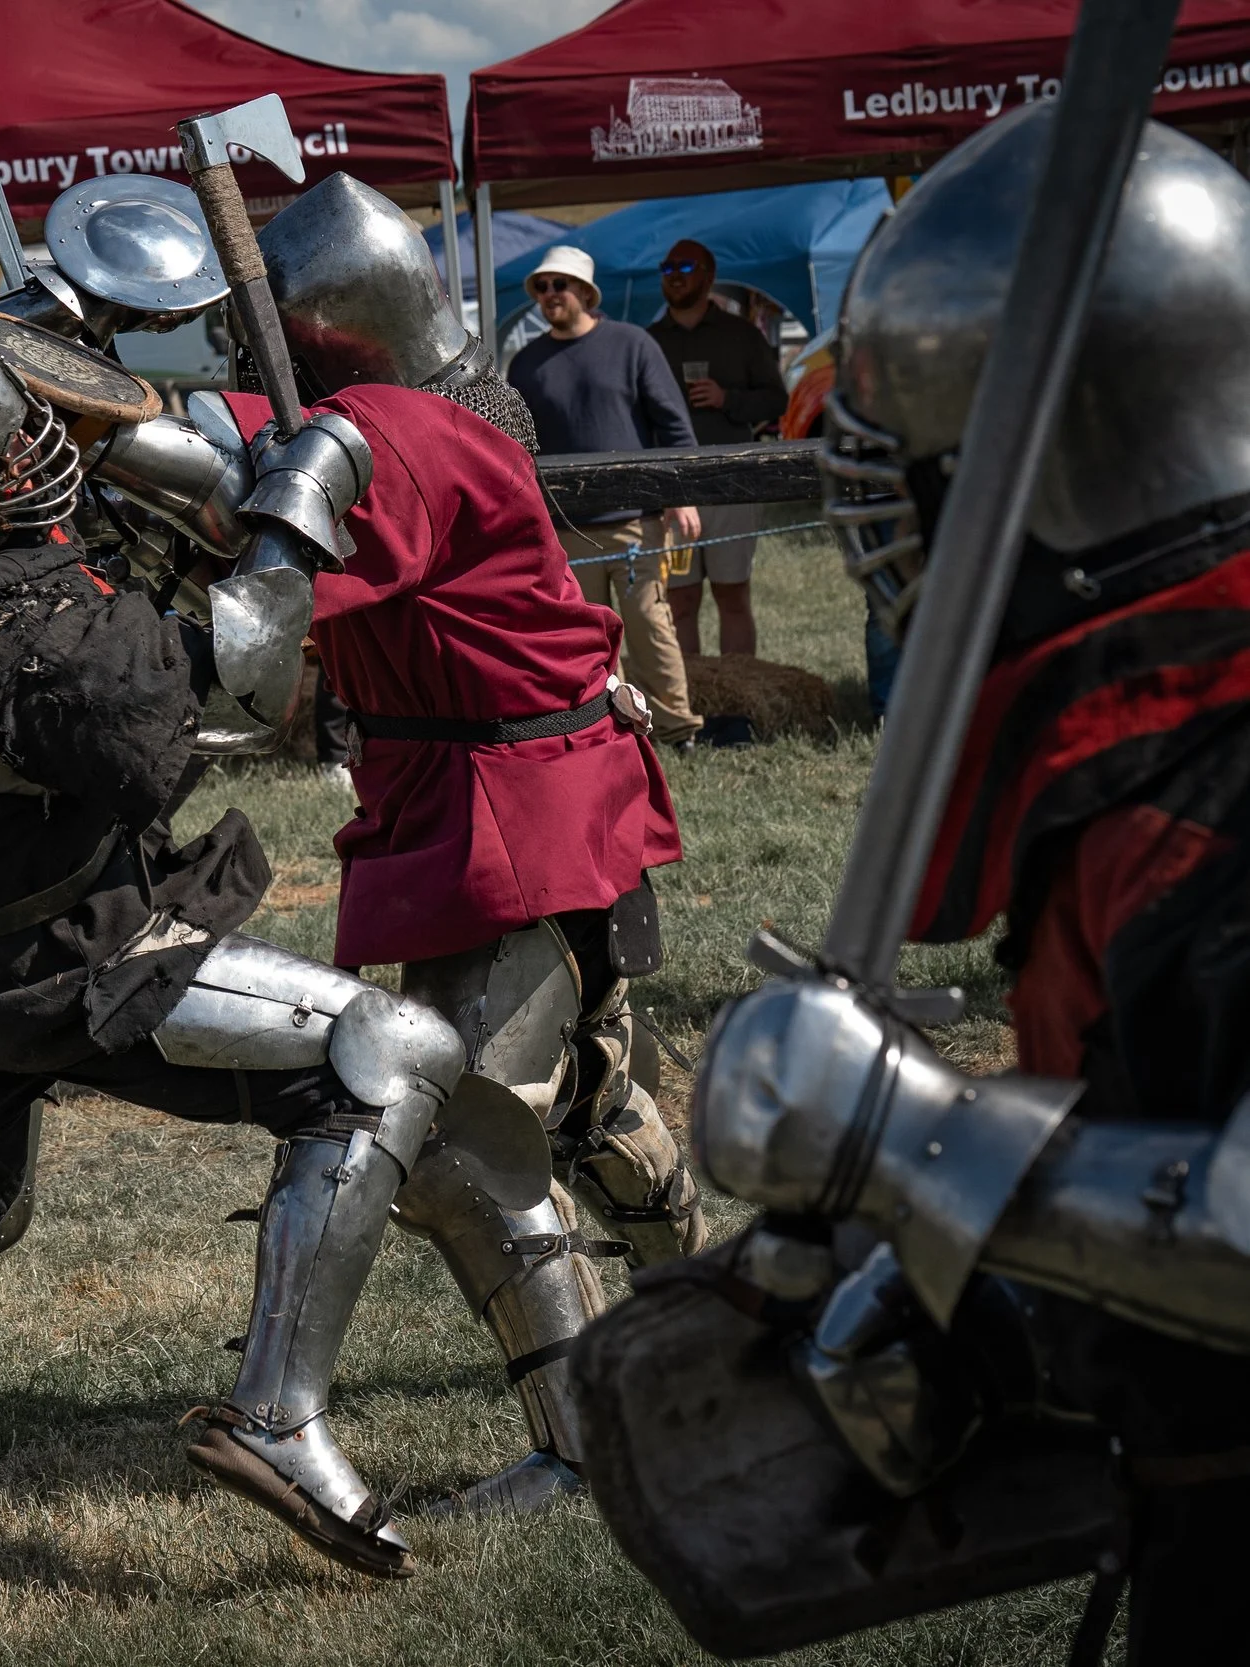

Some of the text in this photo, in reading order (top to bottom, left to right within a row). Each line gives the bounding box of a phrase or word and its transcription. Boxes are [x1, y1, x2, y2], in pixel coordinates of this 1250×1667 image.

[843, 82, 1008, 121] Ledbury
[1016, 73, 1063, 104] To
[228, 122, 350, 165] ocil
